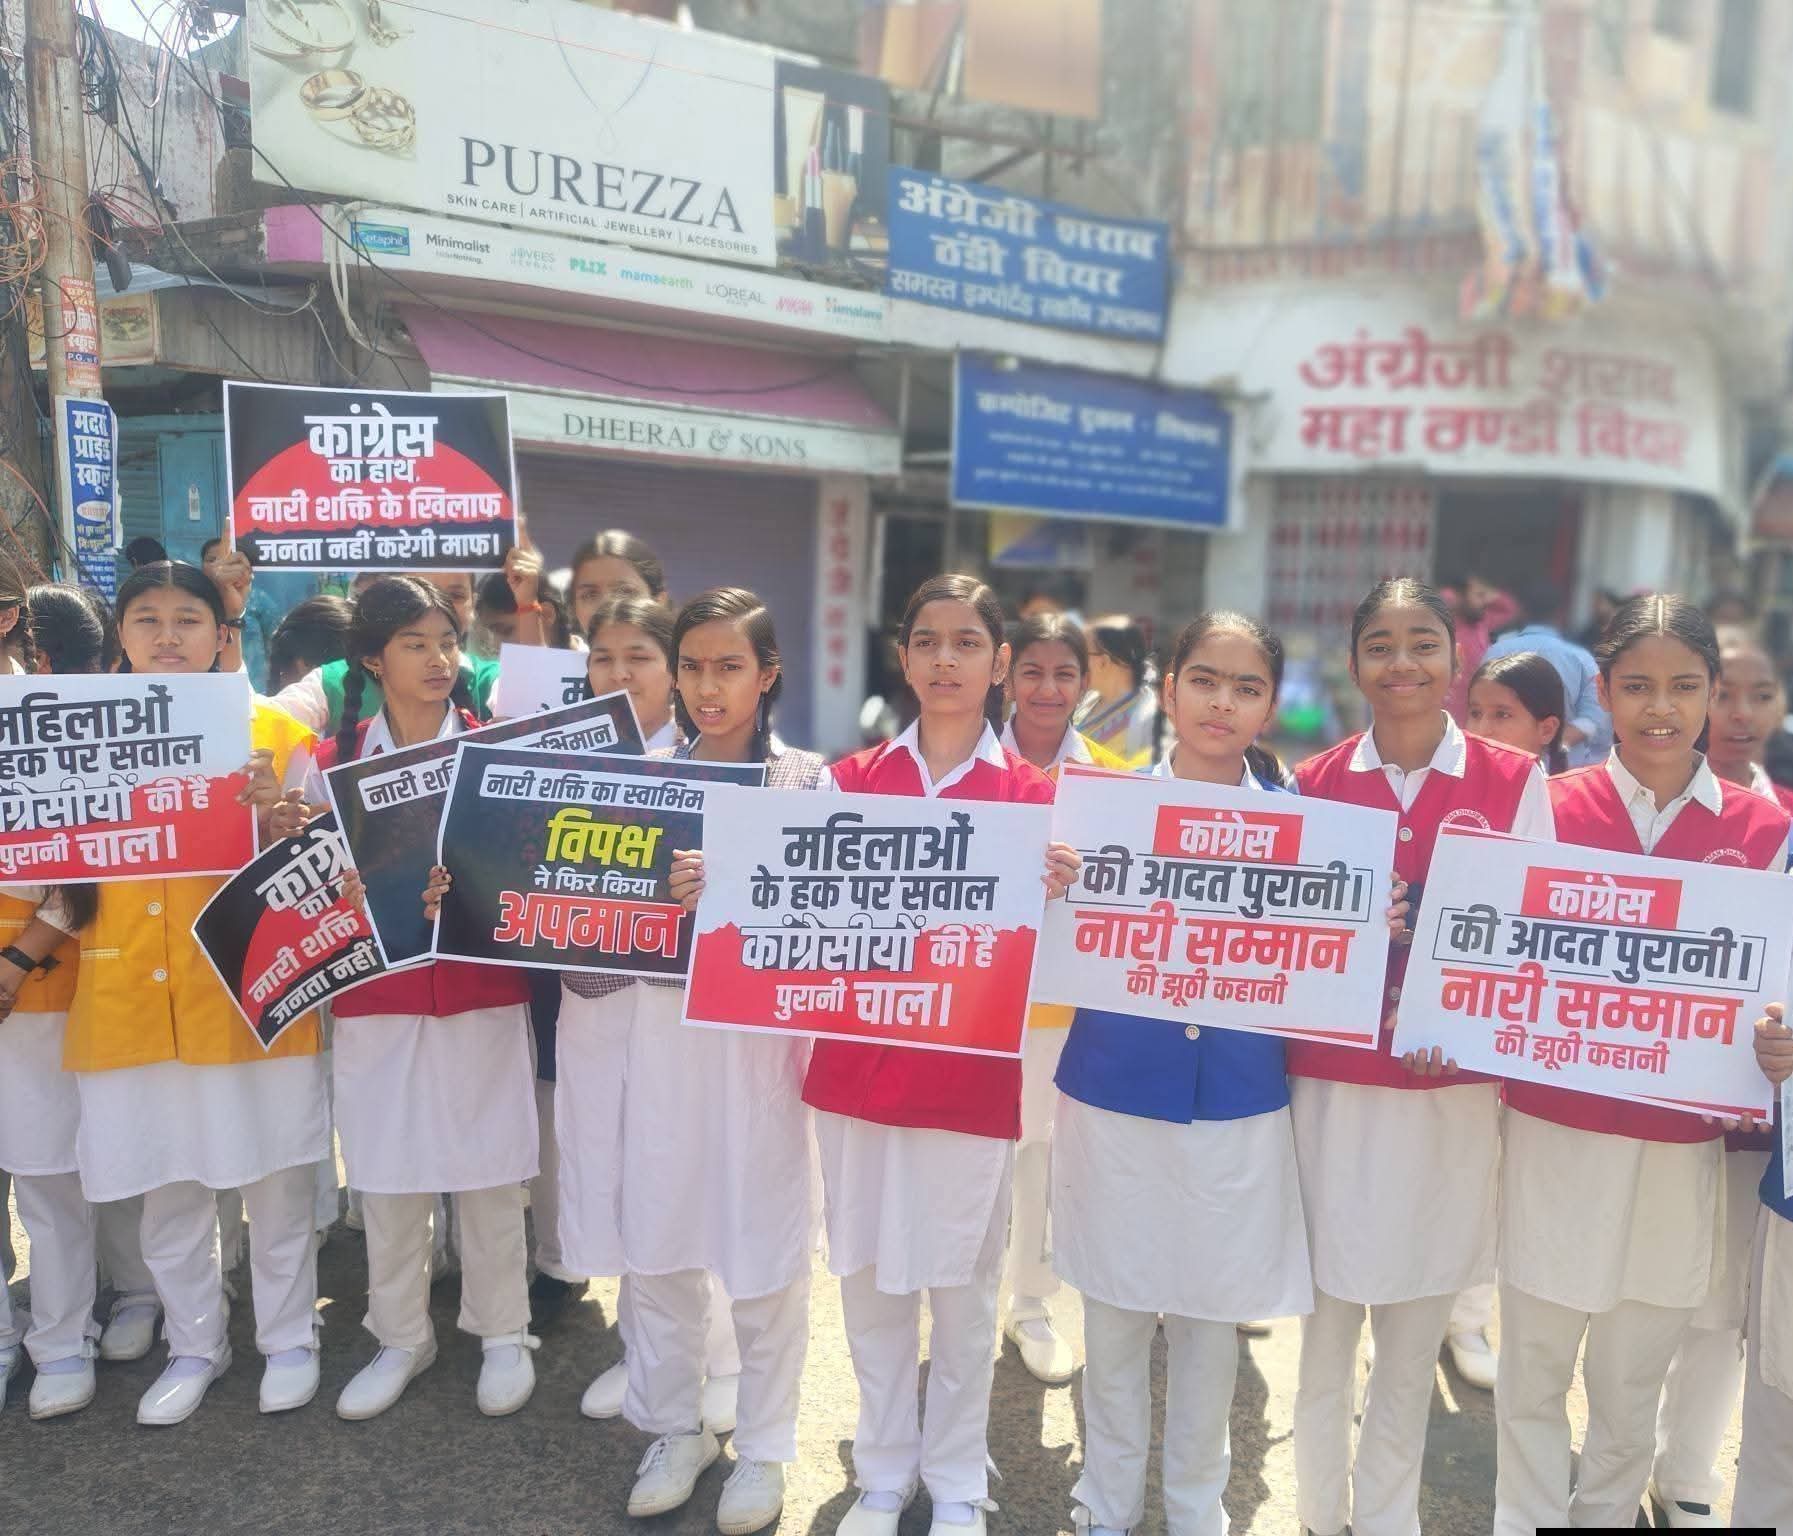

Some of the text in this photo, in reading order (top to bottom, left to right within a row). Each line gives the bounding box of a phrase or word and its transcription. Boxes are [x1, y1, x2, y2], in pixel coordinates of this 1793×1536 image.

[447, 193, 517, 215] SKIN CARE
[459, 136, 744, 234] PUREZZA
[426, 233, 490, 254] Minimalist
[529, 207, 673, 241] ARTIFICIAL JEWELLERY
[897, 178, 1157, 260] अंग्रेजी शराब
[570, 257, 607, 275] PLIX
[687, 234, 759, 256] ACCESORIES
[929, 233, 1123, 297] ठंडी बियर
[620, 267, 694, 290] mamaearth
[1299, 324, 1676, 402] अंग्रेजी शराब
[304, 402, 438, 459] कांग्रेस
[564, 413, 806, 459] DHEERAJ & SONS
[1300, 403, 1407, 457] महा
[328, 459, 363, 484] का
[248, 487, 502, 522] नारी शक्ति के खिलाफ
[255, 528, 499, 563] जनता नहीं करेगी माफ।
[54, 743, 100, 774] पर
[106, 734, 204, 771] सवाल
[144, 777, 184, 813] की
[186, 775, 211, 810] है
[364, 770, 419, 806] नारी
[487, 771, 704, 811] नारी शक्ति का स्वाभिम
[0, 824, 177, 874] पुरानी चाल।
[545, 807, 664, 870] विपक्ष
[782, 811, 975, 872] महिलाओं
[1179, 812, 1280, 860] कांग्रेस
[255, 828, 353, 913] कांग्रे
[533, 864, 657, 897] ने फिर किया
[750, 864, 1000, 912] के हक पर सवाल
[1080, 844, 1363, 919] की आदत पुरानी।
[294, 885, 334, 920] का
[1547, 873, 1655, 925] कांग्रेस
[493, 890, 687, 959] अपमान
[740, 912, 998, 973] कांग्रेसीयों की है
[1074, 901, 1356, 974] नारी सम्मान
[1450, 904, 1752, 984] की आदत पुरानी।
[248, 909, 361, 1003] नारी शक्ति
[269, 939, 378, 1026] जनता नहीं
[773, 977, 953, 1027] पुरानी चाल।
[1126, 963, 1288, 1008] की झूठी कहानी
[1440, 961, 1744, 1046] नारी सम्मान
[1494, 1023, 1670, 1075] की झूठी कहानी
